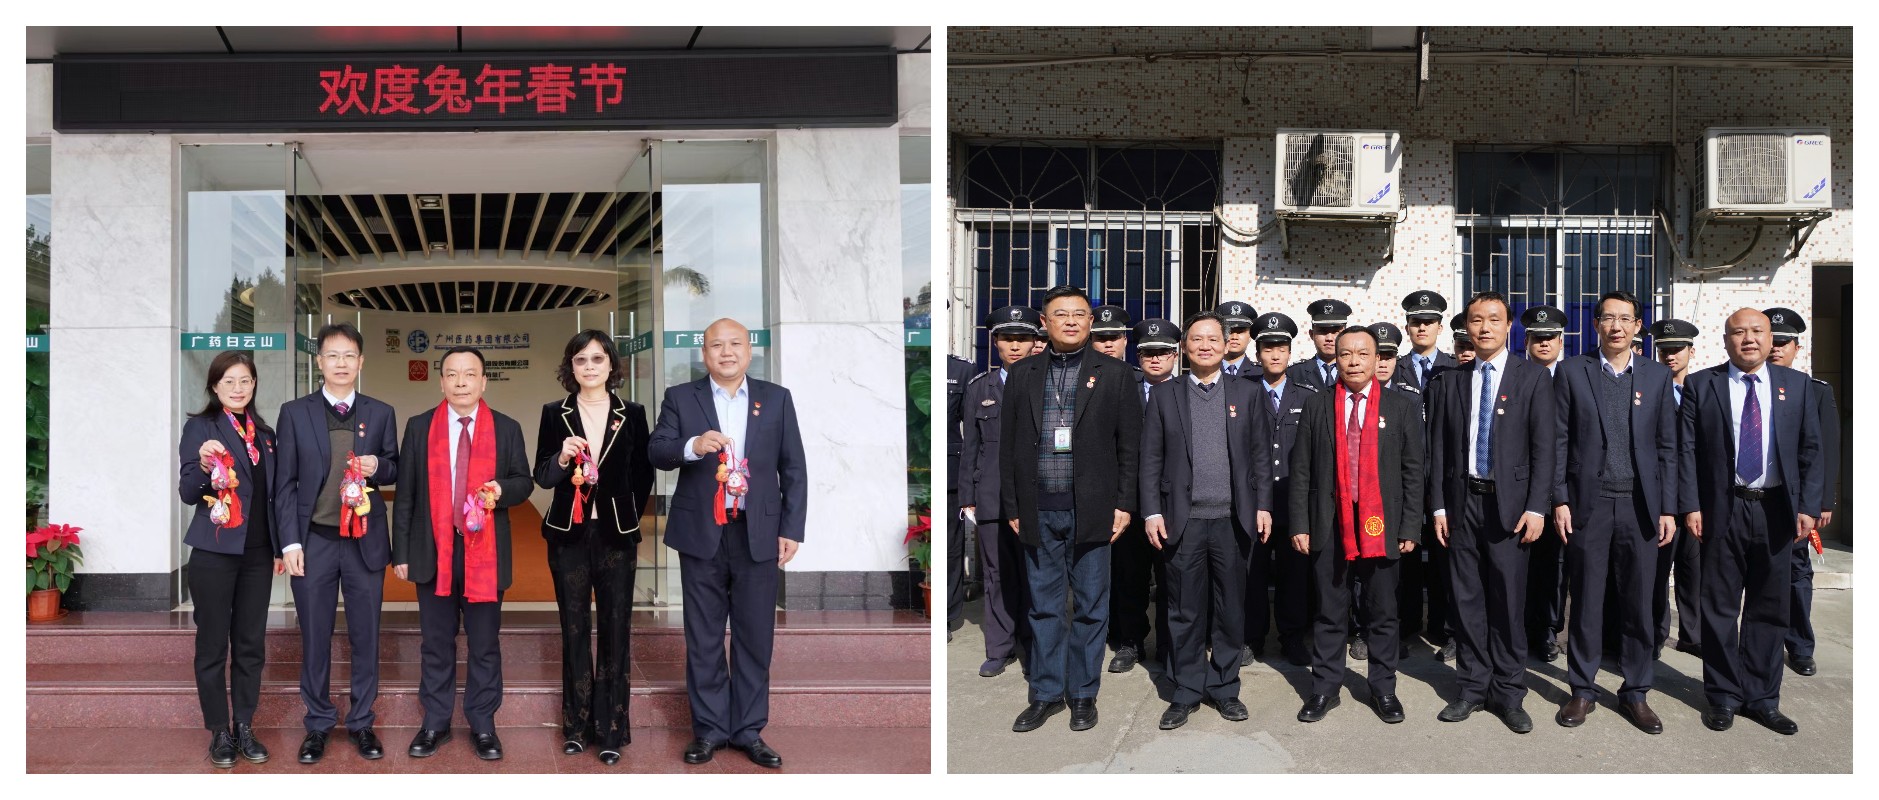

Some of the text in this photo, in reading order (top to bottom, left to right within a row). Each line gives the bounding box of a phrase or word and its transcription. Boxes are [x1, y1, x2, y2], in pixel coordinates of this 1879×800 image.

[318, 62, 627, 115] 欢度兔年春节
[26, 336, 39, 348] 山
[191, 335, 274, 348] 广药白云山
[434, 333, 530, 344] 广州医药集团有限公司
[675, 333, 758, 345] 广药山
[907, 331, 921, 343] 广
